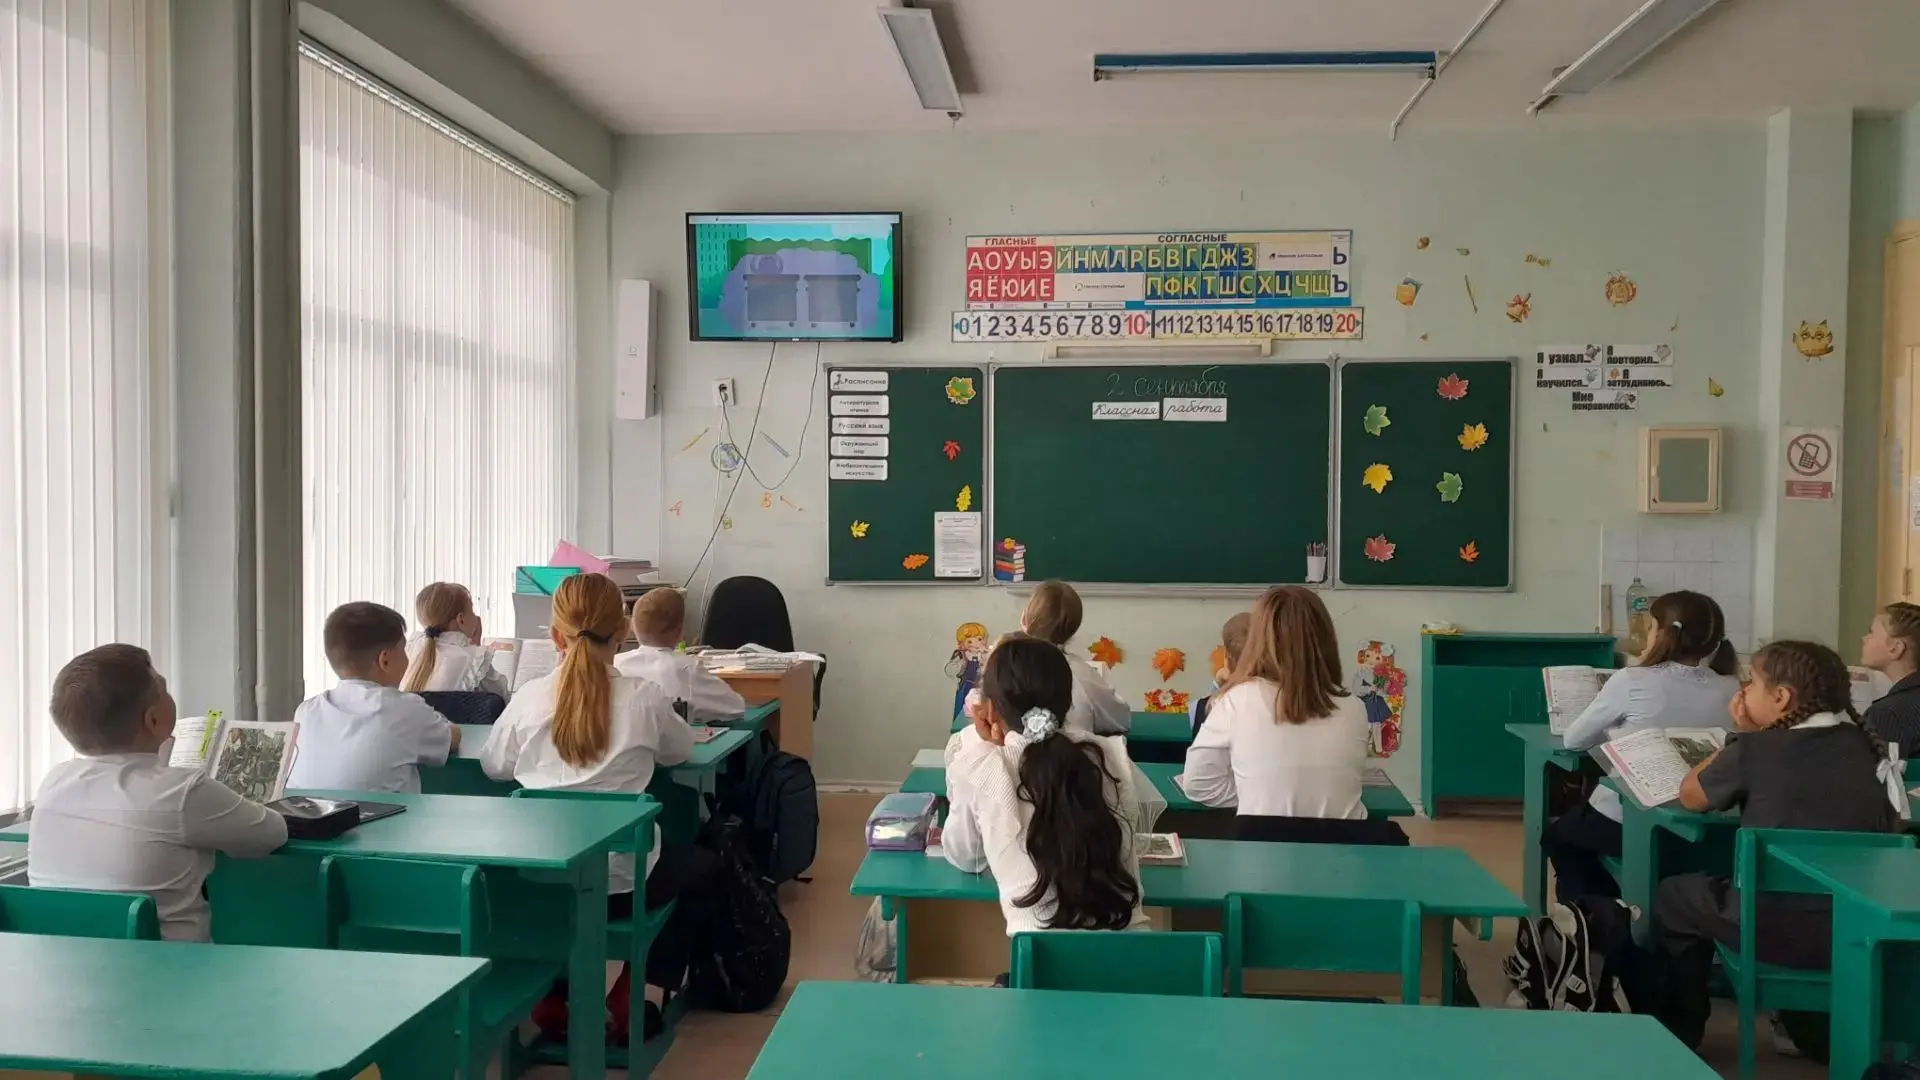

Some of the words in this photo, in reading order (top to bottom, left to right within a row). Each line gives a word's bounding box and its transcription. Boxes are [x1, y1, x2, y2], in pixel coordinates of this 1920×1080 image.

[985, 238, 1037, 246] ГЛАСНЫЕ
[1158, 234, 1228, 243] СОГЛАСНЫЕ
[1607, 346, 1614, 355] Я
[1537, 352, 1544, 364] Я
[1537, 369, 1543, 379] Я
[1623, 369, 1630, 379] Я
[844, 377, 887, 385] Расписание
[1107, 372, 1124, 397] 2
[1572, 392, 1594, 402] Мне
[1093, 403, 1157, 416] Классная
[1164, 400, 1224, 419] работа
